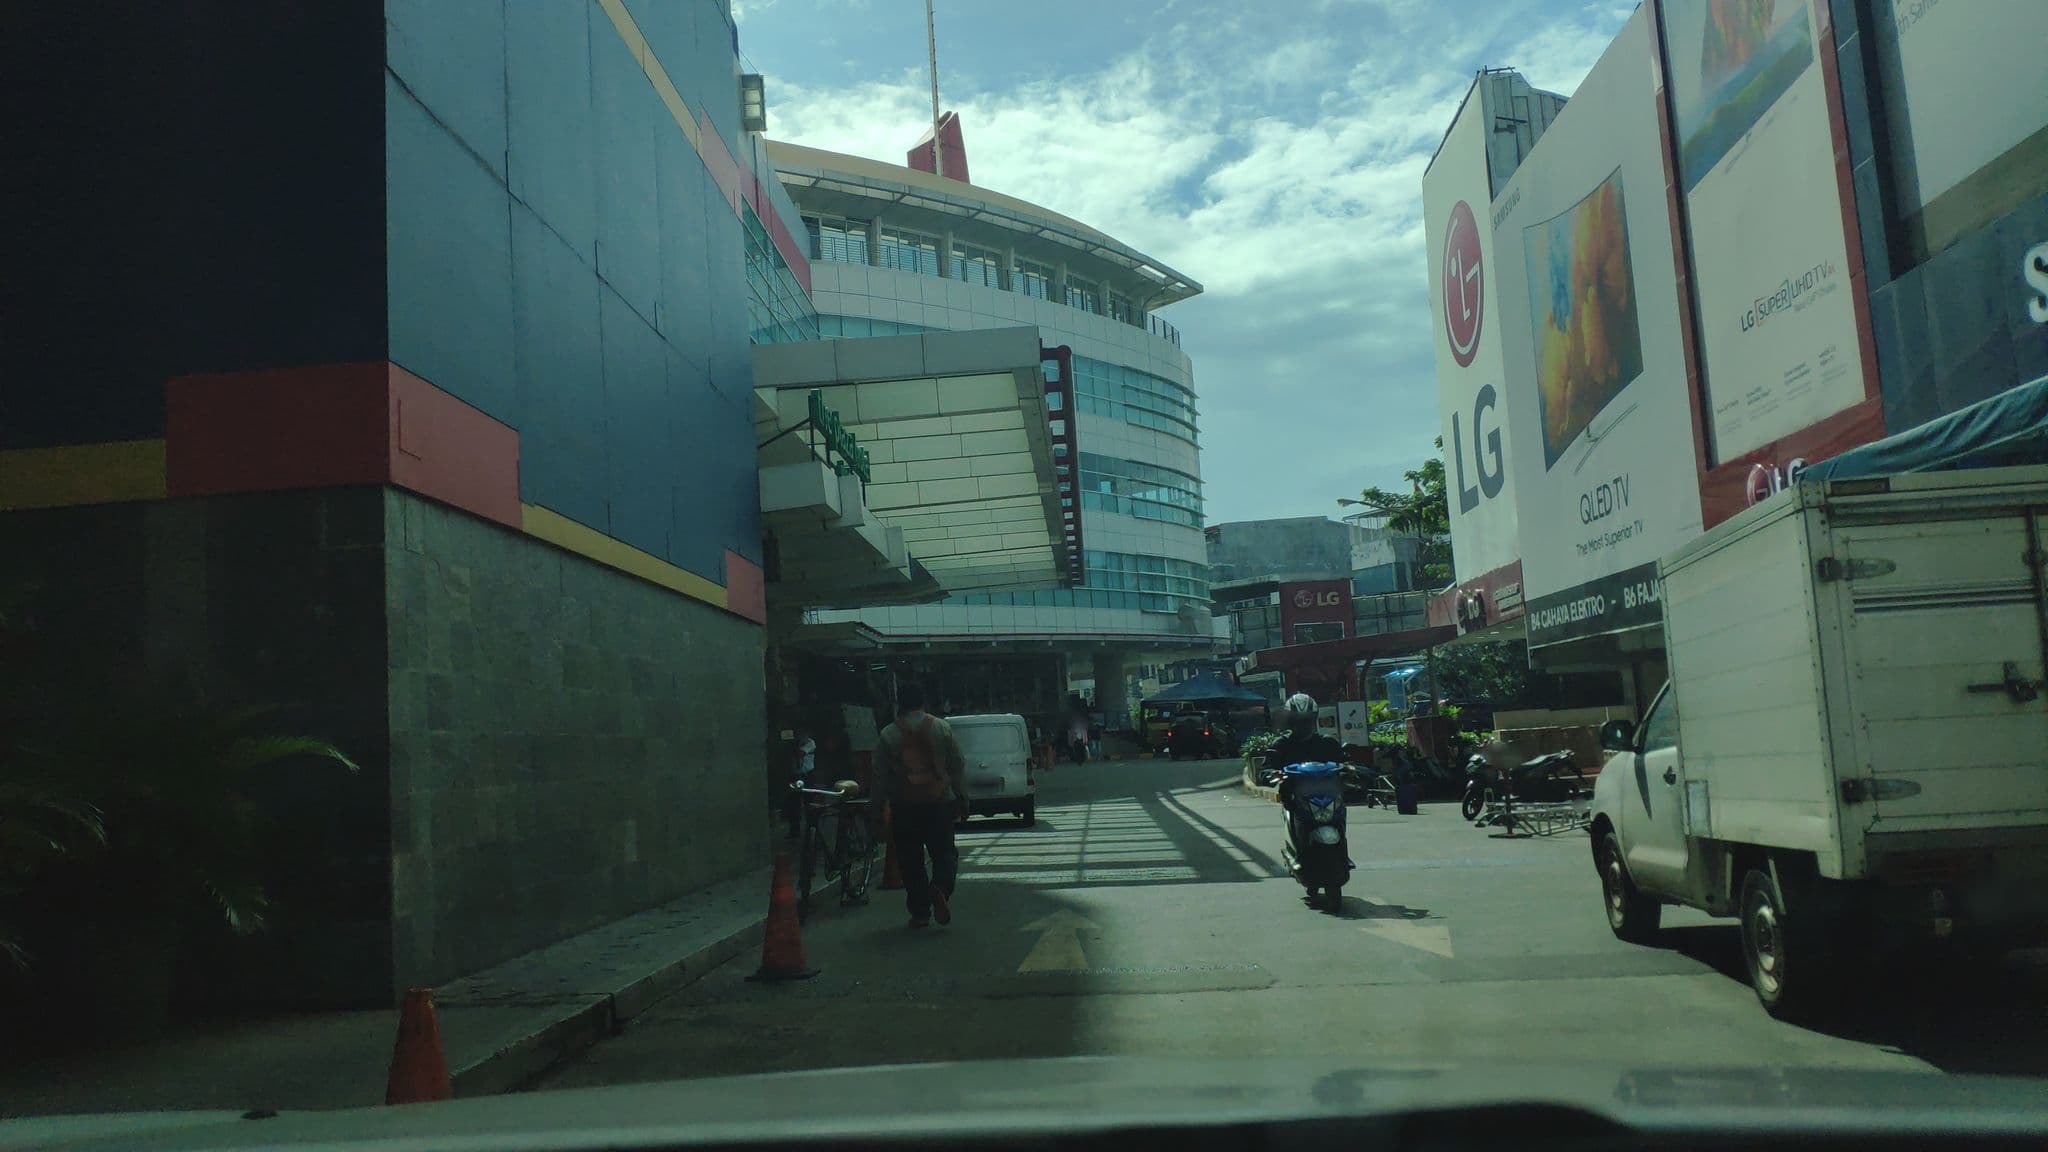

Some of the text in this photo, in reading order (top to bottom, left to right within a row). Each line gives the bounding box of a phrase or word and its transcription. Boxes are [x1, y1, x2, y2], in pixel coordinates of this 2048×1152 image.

[1741, 310, 1755, 333] LG
[1452, 383, 1505, 516] LG
[1580, 472, 1629, 525] QLED TV
[1316, 591, 1340, 606] LG
[1570, 595, 1605, 621] ELEKTRO
[1624, 586, 1636, 609] B6
